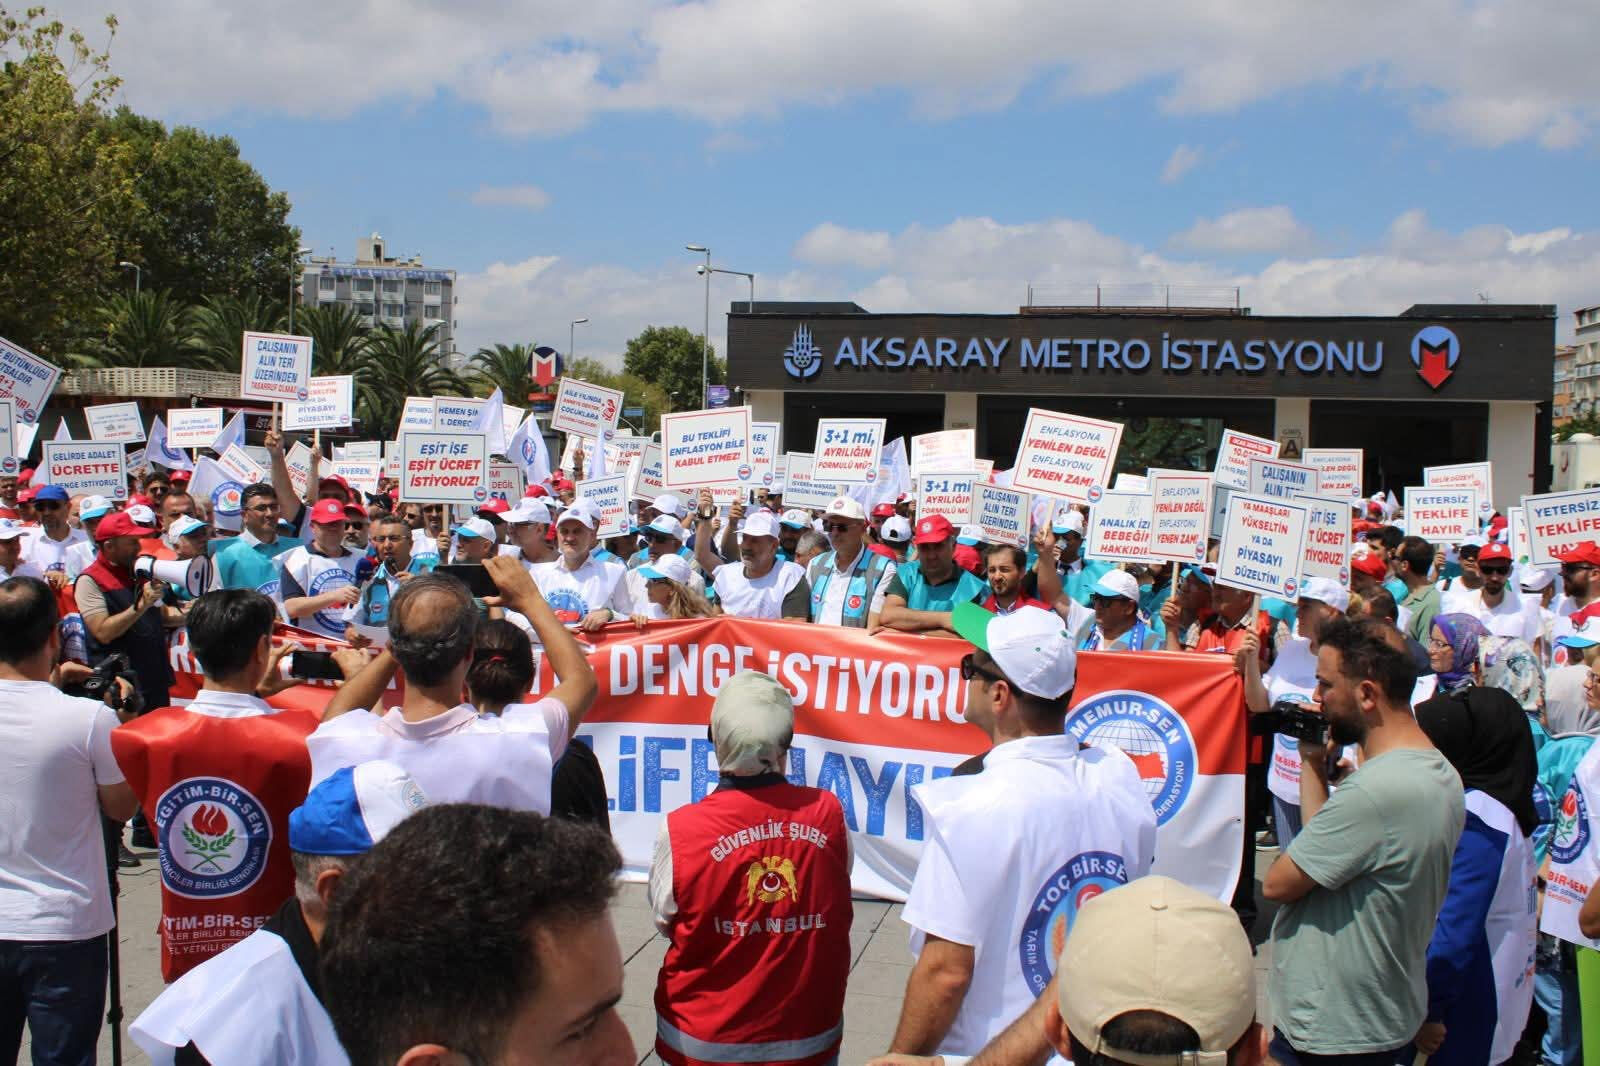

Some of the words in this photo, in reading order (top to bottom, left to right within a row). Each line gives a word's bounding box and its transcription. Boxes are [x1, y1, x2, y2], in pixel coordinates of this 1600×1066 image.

[834, 337, 1009, 368] AKSARAY
[1020, 337, 1151, 370] METRO
[1161, 332, 1384, 372] İSTASYONU
[682, 433, 695, 443] BU
[697, 427, 731, 440] TEKLİFİ
[824, 429, 848, 444] 3+1
[1040, 425, 1101, 441] ENFLASYONA
[53, 451, 86, 461] GELİRDE
[88, 450, 116, 459] ADALET
[420, 441, 447, 456] EŞİT
[449, 441, 469, 456] İŞE
[669, 441, 723, 457] ENFLASYON
[725, 438, 745, 450] BİLE
[824, 445, 872, 457] AYRILIĞIN
[1027, 438, 1072, 454] YENİLEN
[1074, 445, 1107, 459] DEĞİL
[1284, 440, 1300, 456] A
[408, 457, 436, 472] EŞİT
[439, 457, 481, 471] ÜCRET
[675, 456, 705, 468] KABUL
[707, 452, 741, 464] ETMEZ!
[1031, 454, 1094, 472] ENFLASYONU
[52, 463, 119, 476] ÜCRETTE
[1026, 467, 1063, 482] YENEN
[1064, 474, 1095, 487] ZAM!
[410, 474, 480, 487] İSTİYORUZ!
[925, 480, 952, 493] 3+1
[1264, 482, 1283, 498] ALIN
[984, 502, 1000, 514] ALIN
[1156, 500, 1183, 512] YENİLEN
[1184, 500, 1205, 513] DEĞİL
[1242, 502, 1252, 511] YA
[1415, 495, 1468, 505] YETERSİZ
[1535, 499, 1599, 517] YETERSİZ
[1323, 508, 1337, 525] İŞE
[1413, 507, 1469, 519] TEKLİFE
[1100, 518, 1136, 528] ANALIK
[1241, 515, 1288, 535] YÜKSELTİN
[1421, 525, 1463, 535] HAYIR
[1536, 517, 1600, 537] TEKLİFE
[1157, 533, 1178, 543] YENEN
[1180, 534, 1199, 545] ZAM!
[1251, 535, 1262, 545] YA
[1262, 537, 1273, 547] DA
[1316, 527, 1345, 545] ÜCRET
[1237, 546, 1283, 567] PİYASAYI
[1234, 565, 1280, 585] DÜZELTİN!
[767, 649, 970, 725] İSTİYORU
[1069, 700, 1182, 745] MEMUR-SEN
[1155, 760, 1185, 817] DERASYONU
[156, 784, 265, 835] EĞİTİM-BİR-SEN
[710, 819, 784, 862] GÜVENLİK
[788, 821, 828, 849] ŞUBE
[1037, 874, 1072, 914] TOÇ
[714, 913, 827, 937] İSTANBUL
